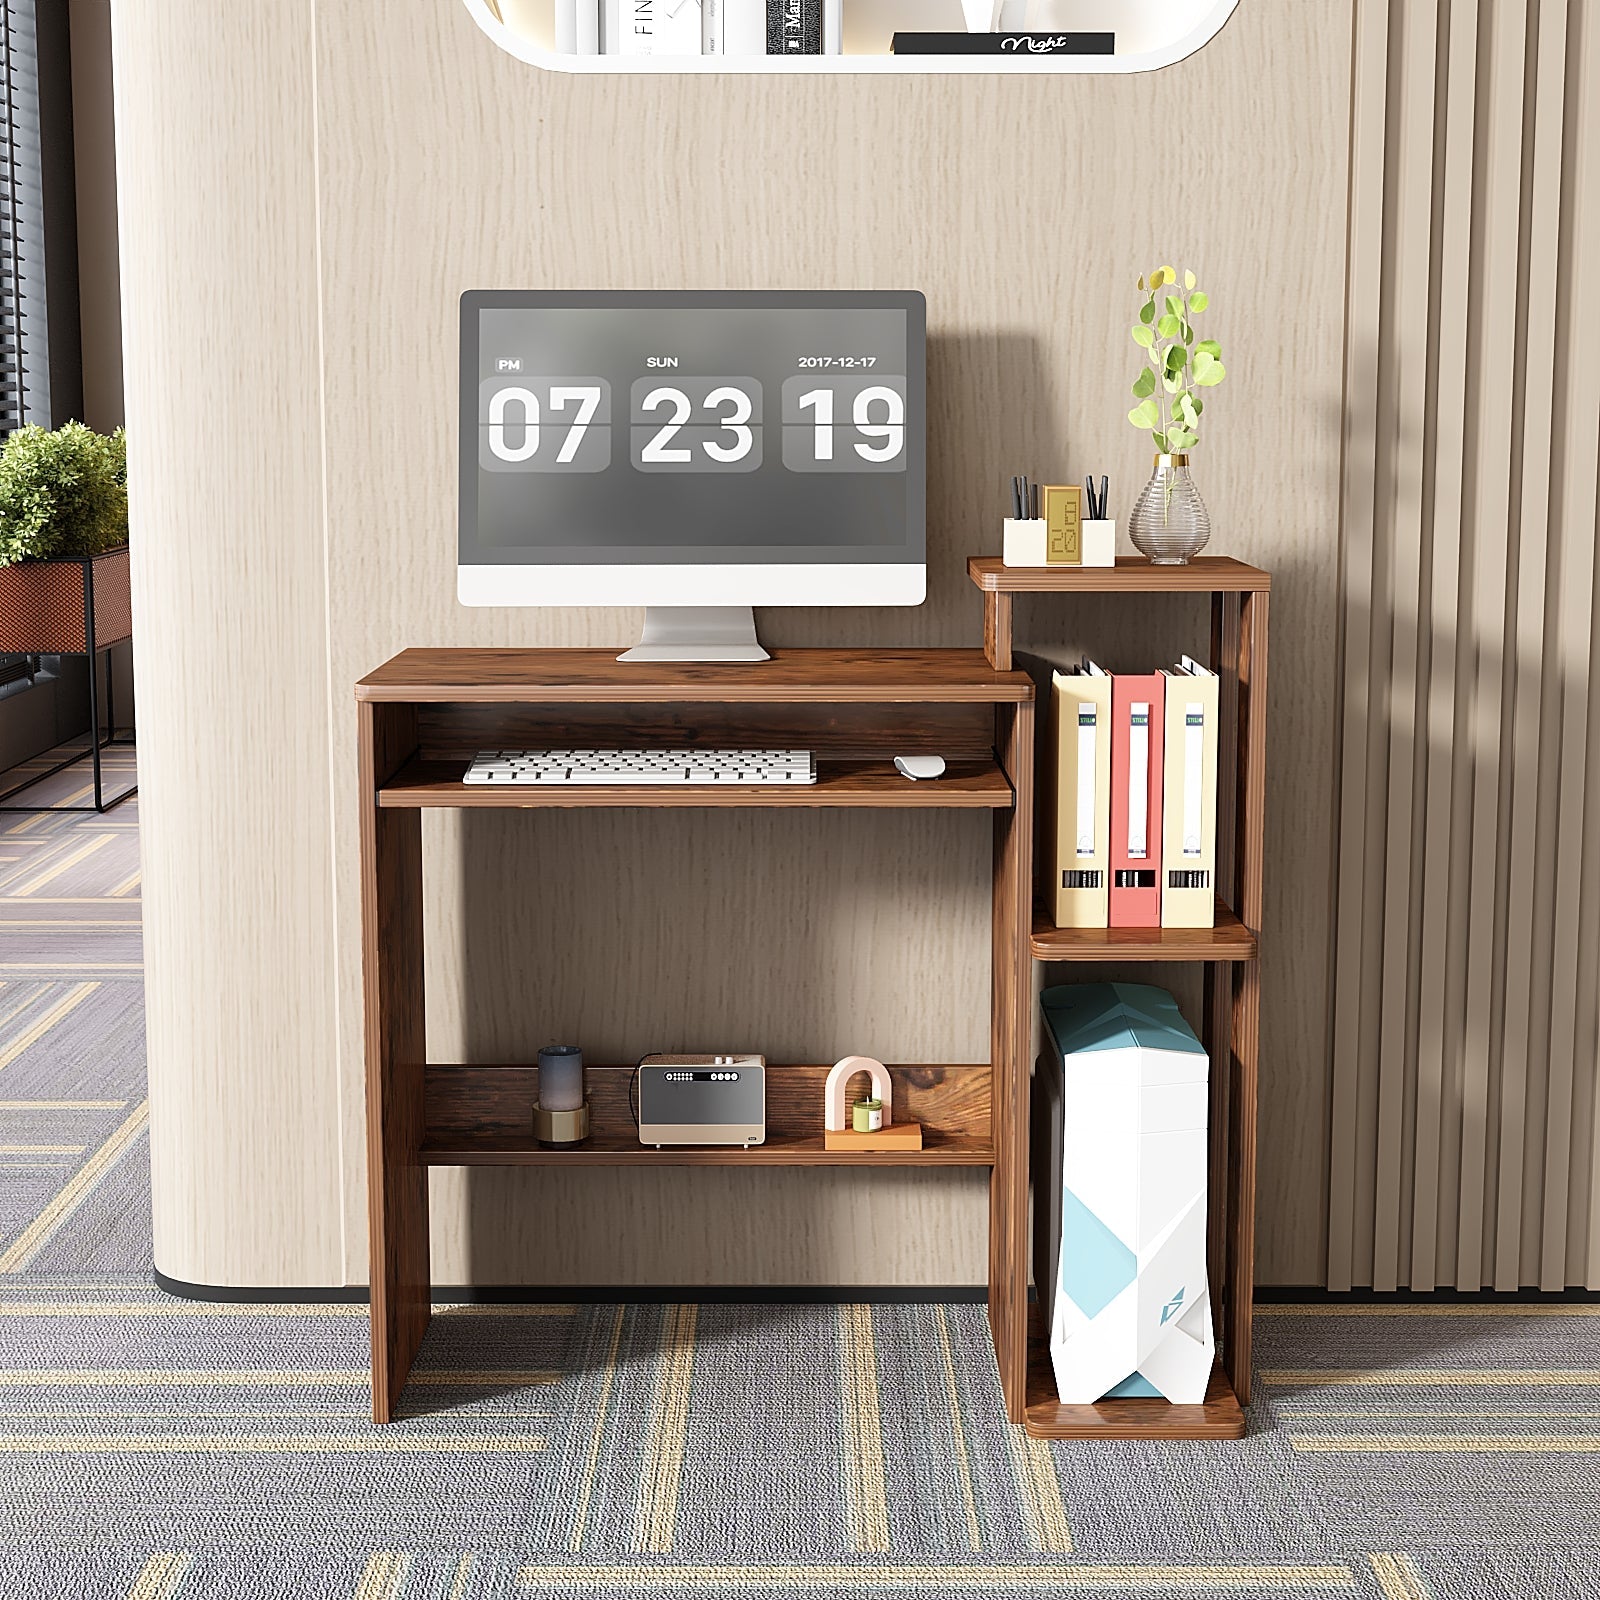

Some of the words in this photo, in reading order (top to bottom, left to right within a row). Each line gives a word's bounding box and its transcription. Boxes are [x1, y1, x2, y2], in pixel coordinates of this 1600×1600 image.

[498, 359, 521, 371] PM
[646, 356, 679, 368] SUN
[798, 356, 877, 368] 2017-12-17
[488, 386, 601, 464] 07
[641, 386, 754, 464] 23
[799, 385, 904, 463] 19
